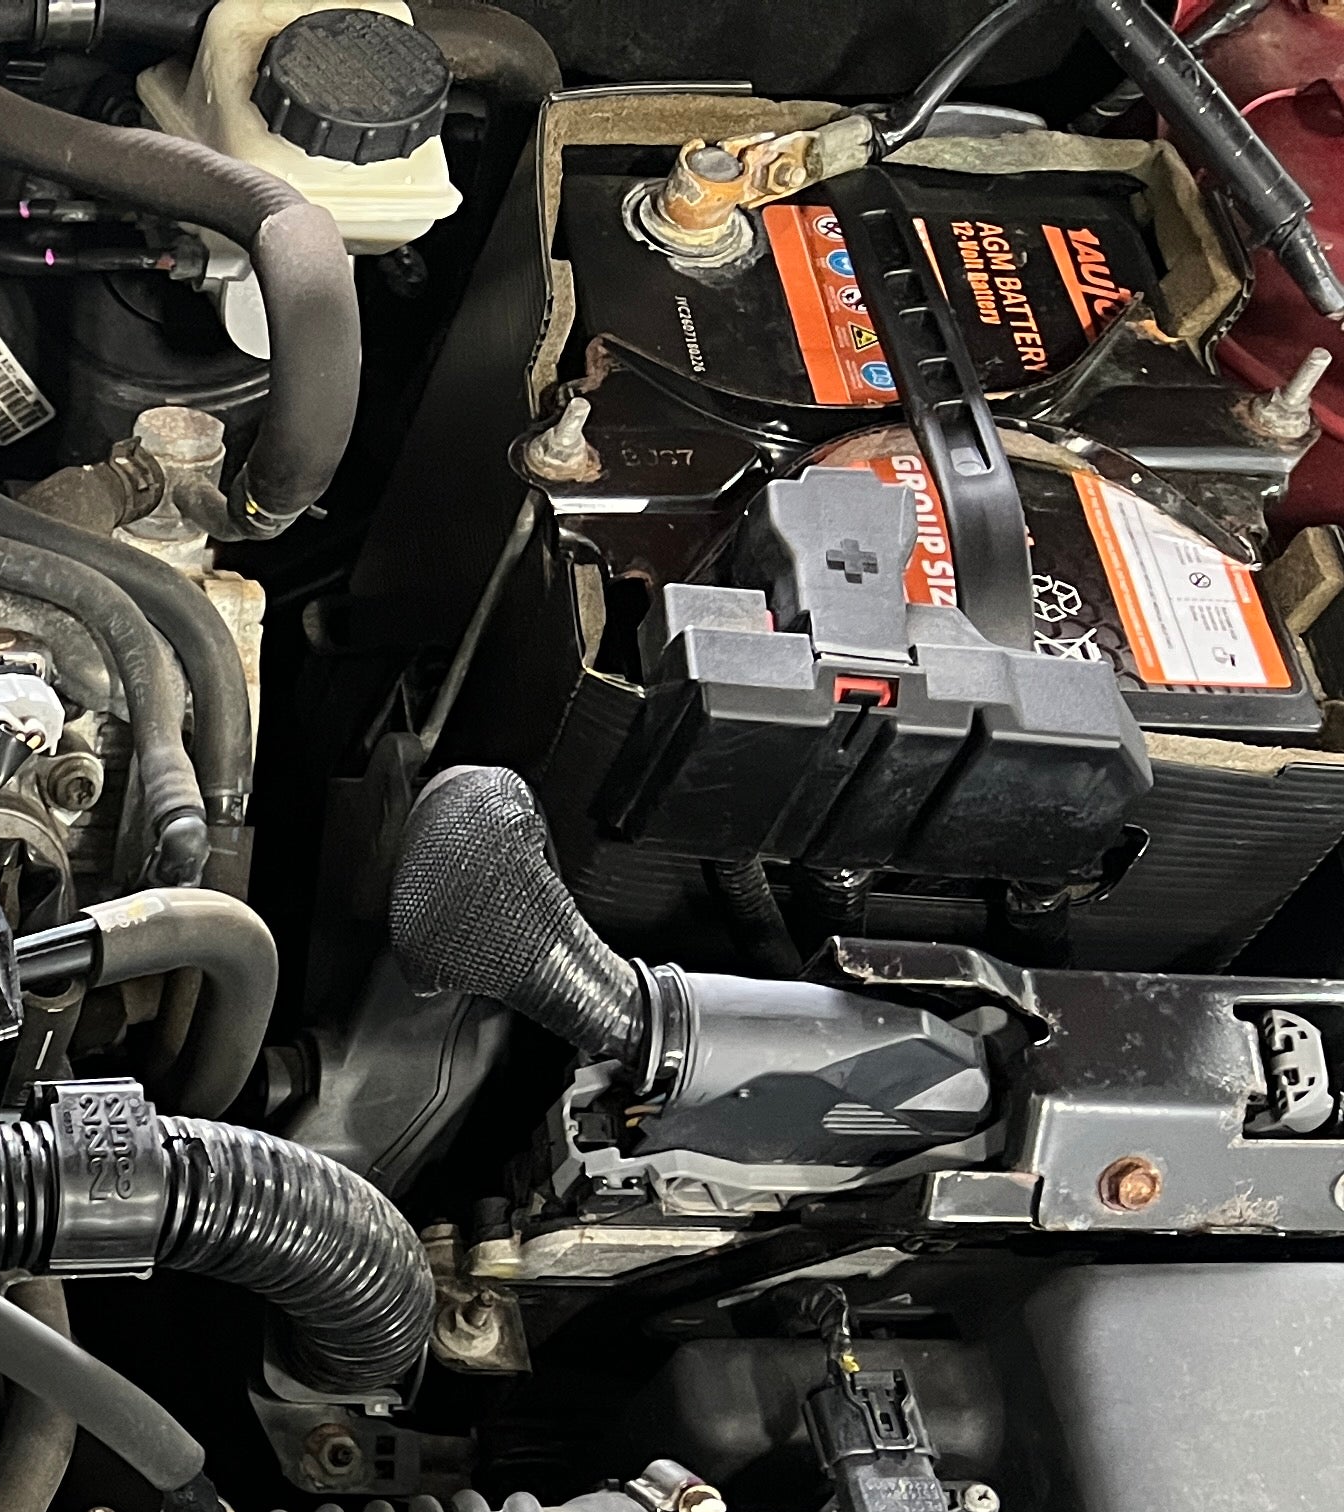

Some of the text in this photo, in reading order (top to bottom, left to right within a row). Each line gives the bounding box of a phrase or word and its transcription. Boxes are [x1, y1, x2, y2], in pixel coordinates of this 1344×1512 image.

[967, 271, 1002, 325] Battery
[975, 221, 1050, 372] AGM BATTERY
[890, 455, 958, 607] GROUP SIZ
[79, 1094, 128, 1126] 22
[85, 1125, 133, 1158] 25
[88, 1157, 133, 1201] 28
